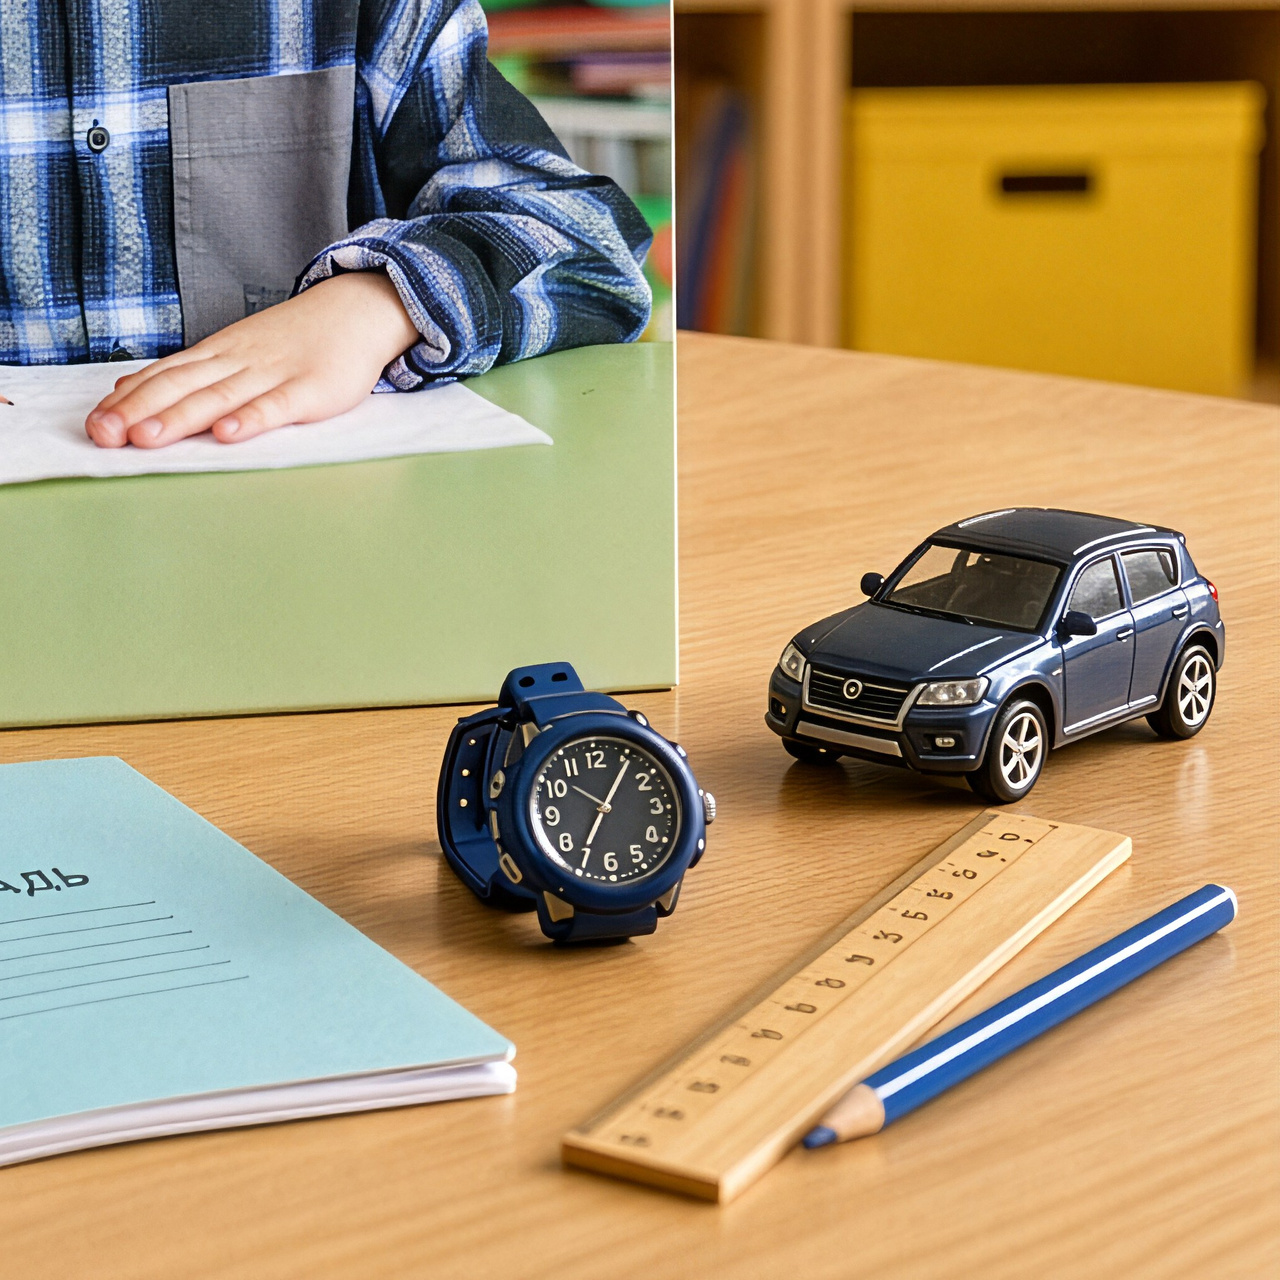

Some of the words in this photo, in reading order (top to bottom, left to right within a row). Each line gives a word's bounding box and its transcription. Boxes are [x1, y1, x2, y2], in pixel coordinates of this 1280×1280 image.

[564, 758, 579, 777] 11
[585, 750, 607, 769] 12
[546, 778, 567, 799] 10
[635, 772, 652, 791] 2
[649, 797, 664, 815] 3
[545, 806, 560, 826] 9
[559, 832, 573, 852] 8
[604, 852, 618, 872] 6
[629, 845, 643, 864] 5
